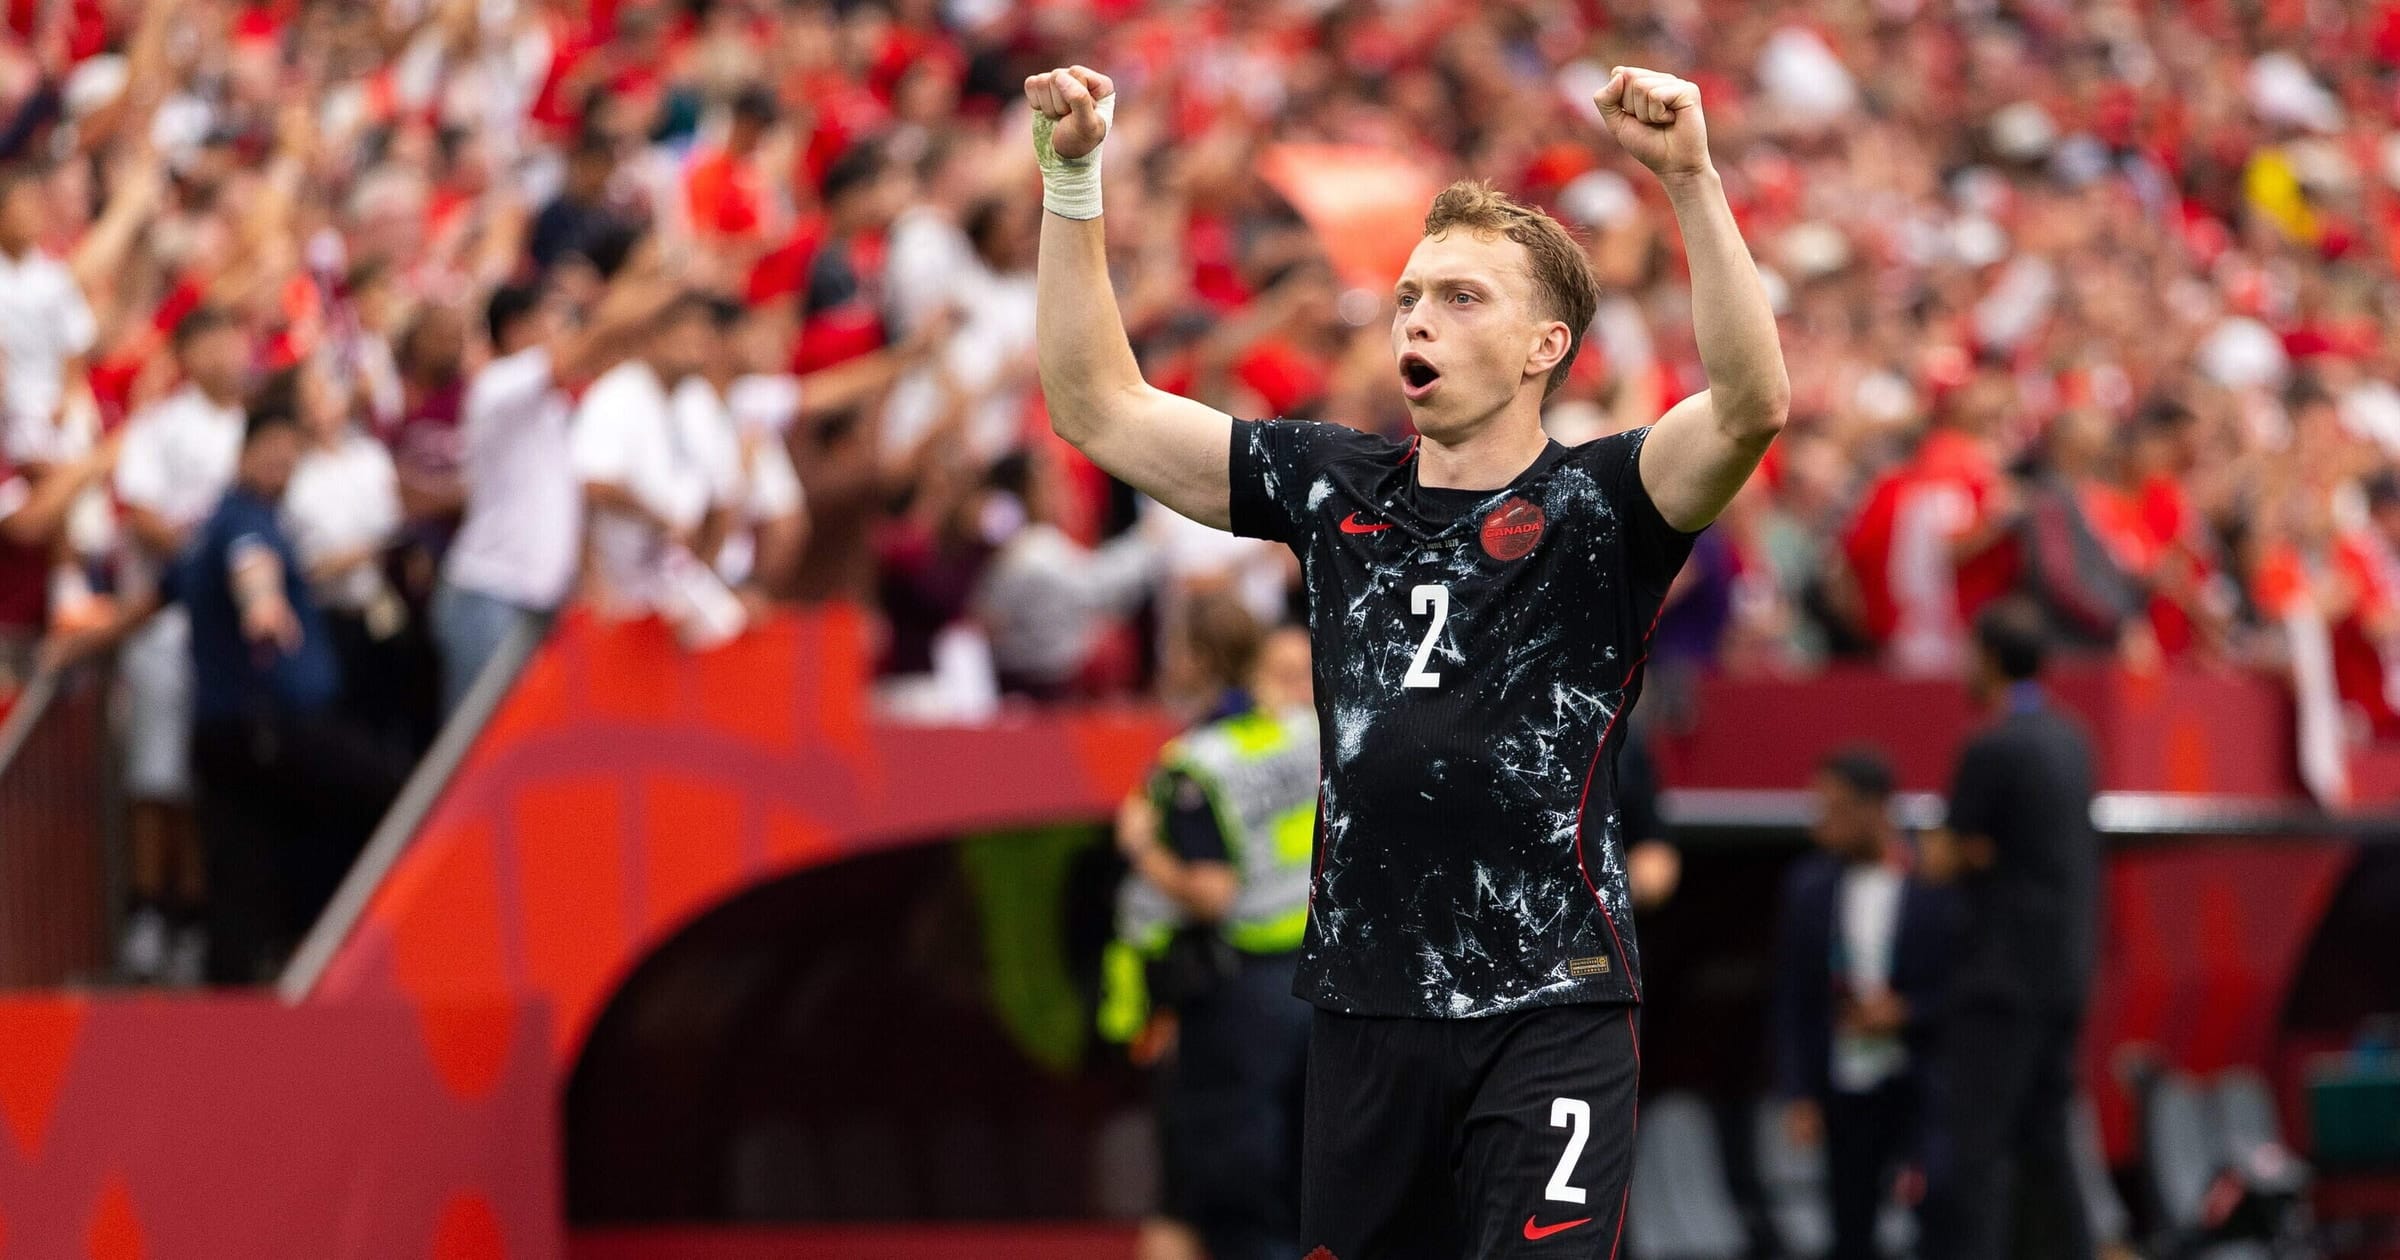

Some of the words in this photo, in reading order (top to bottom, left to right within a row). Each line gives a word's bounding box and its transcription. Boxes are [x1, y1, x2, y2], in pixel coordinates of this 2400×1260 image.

[1484, 523, 1540, 537] CANADA
[1403, 584, 1449, 688] 2
[1545, 1097, 1590, 1204] 2
